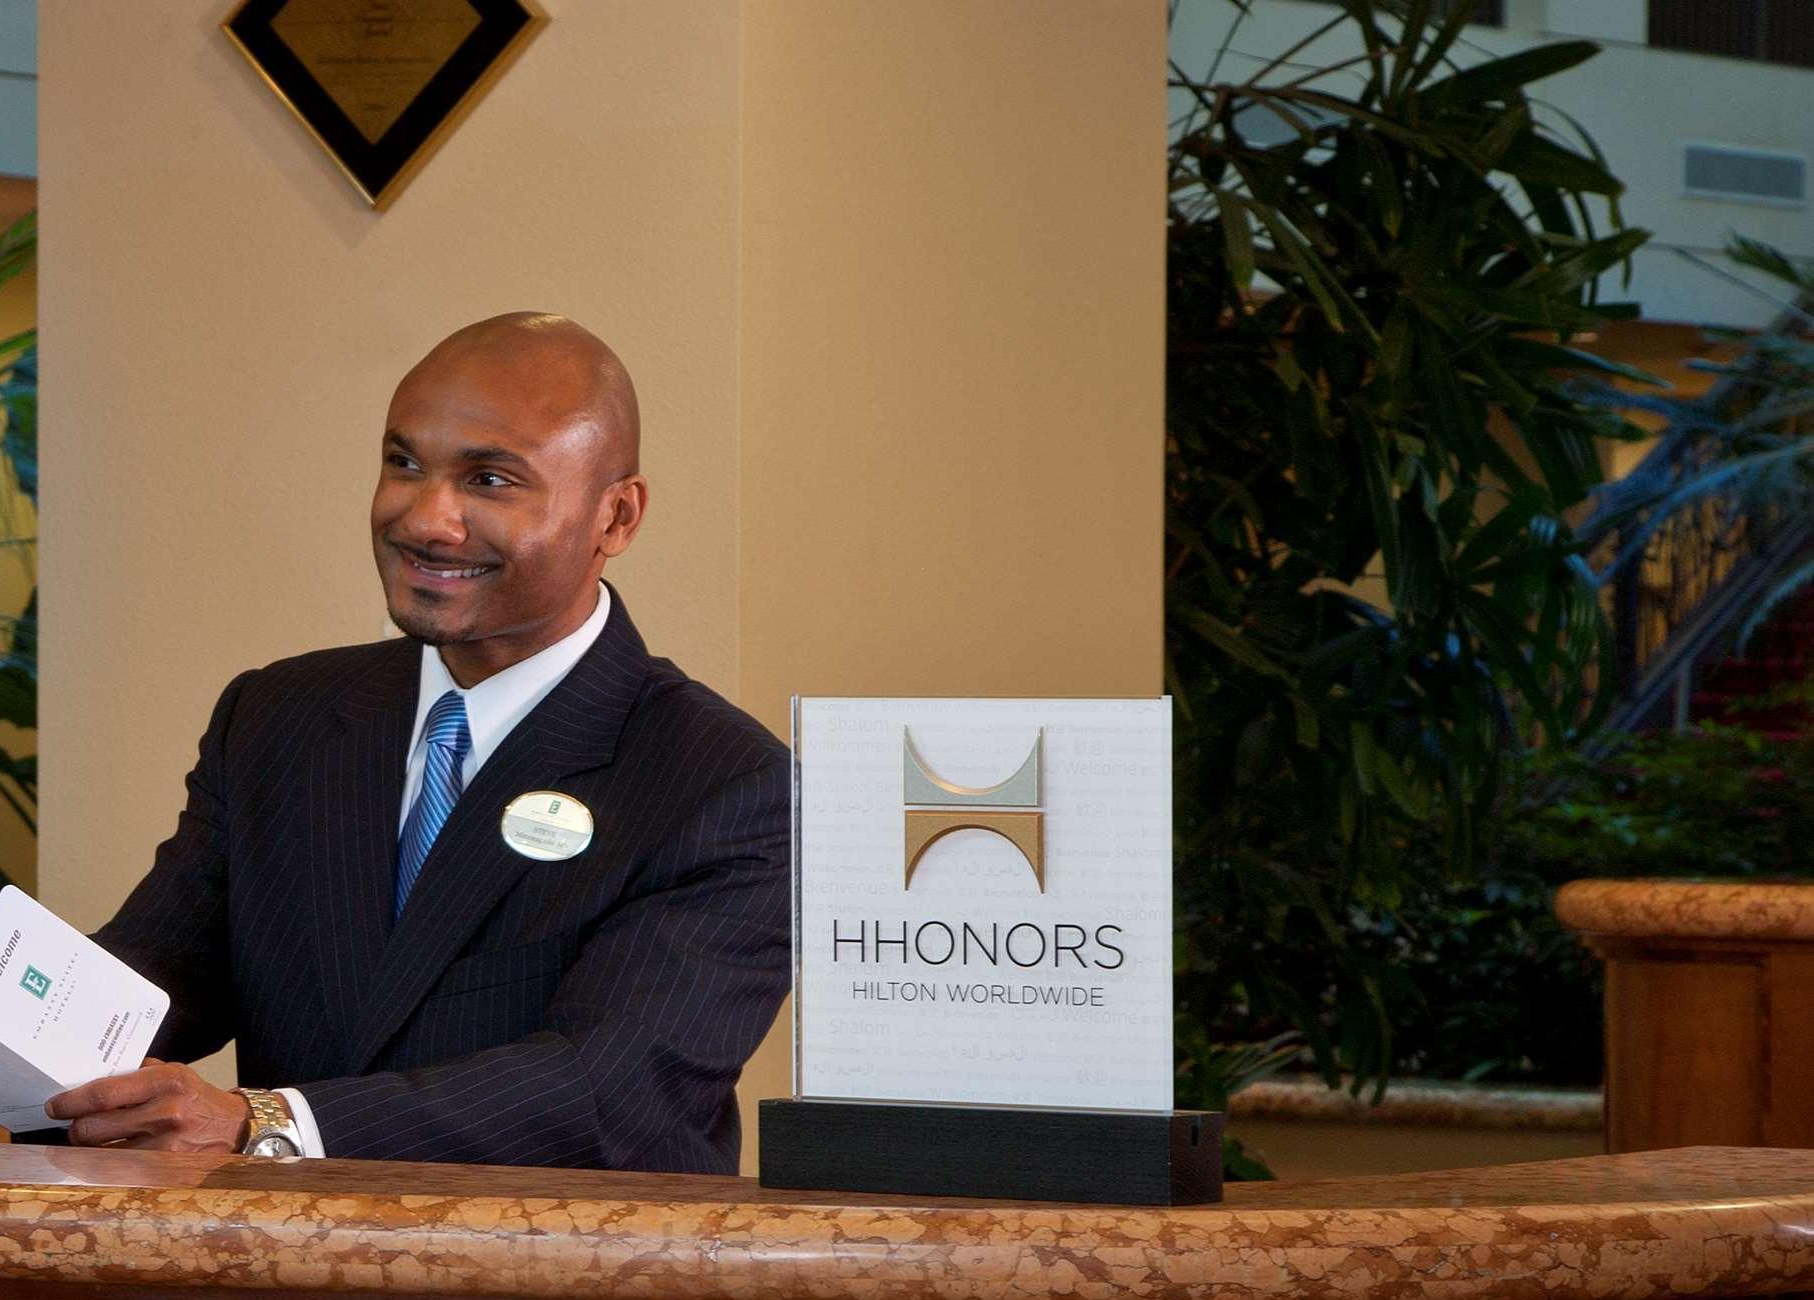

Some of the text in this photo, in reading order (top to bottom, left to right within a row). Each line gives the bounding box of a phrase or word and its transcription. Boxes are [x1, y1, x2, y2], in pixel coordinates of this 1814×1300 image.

[833, 919, 1125, 970] HHONORS
[852, 981, 937, 1003] HILTON
[946, 983, 1105, 1007] WORLDWIDE
